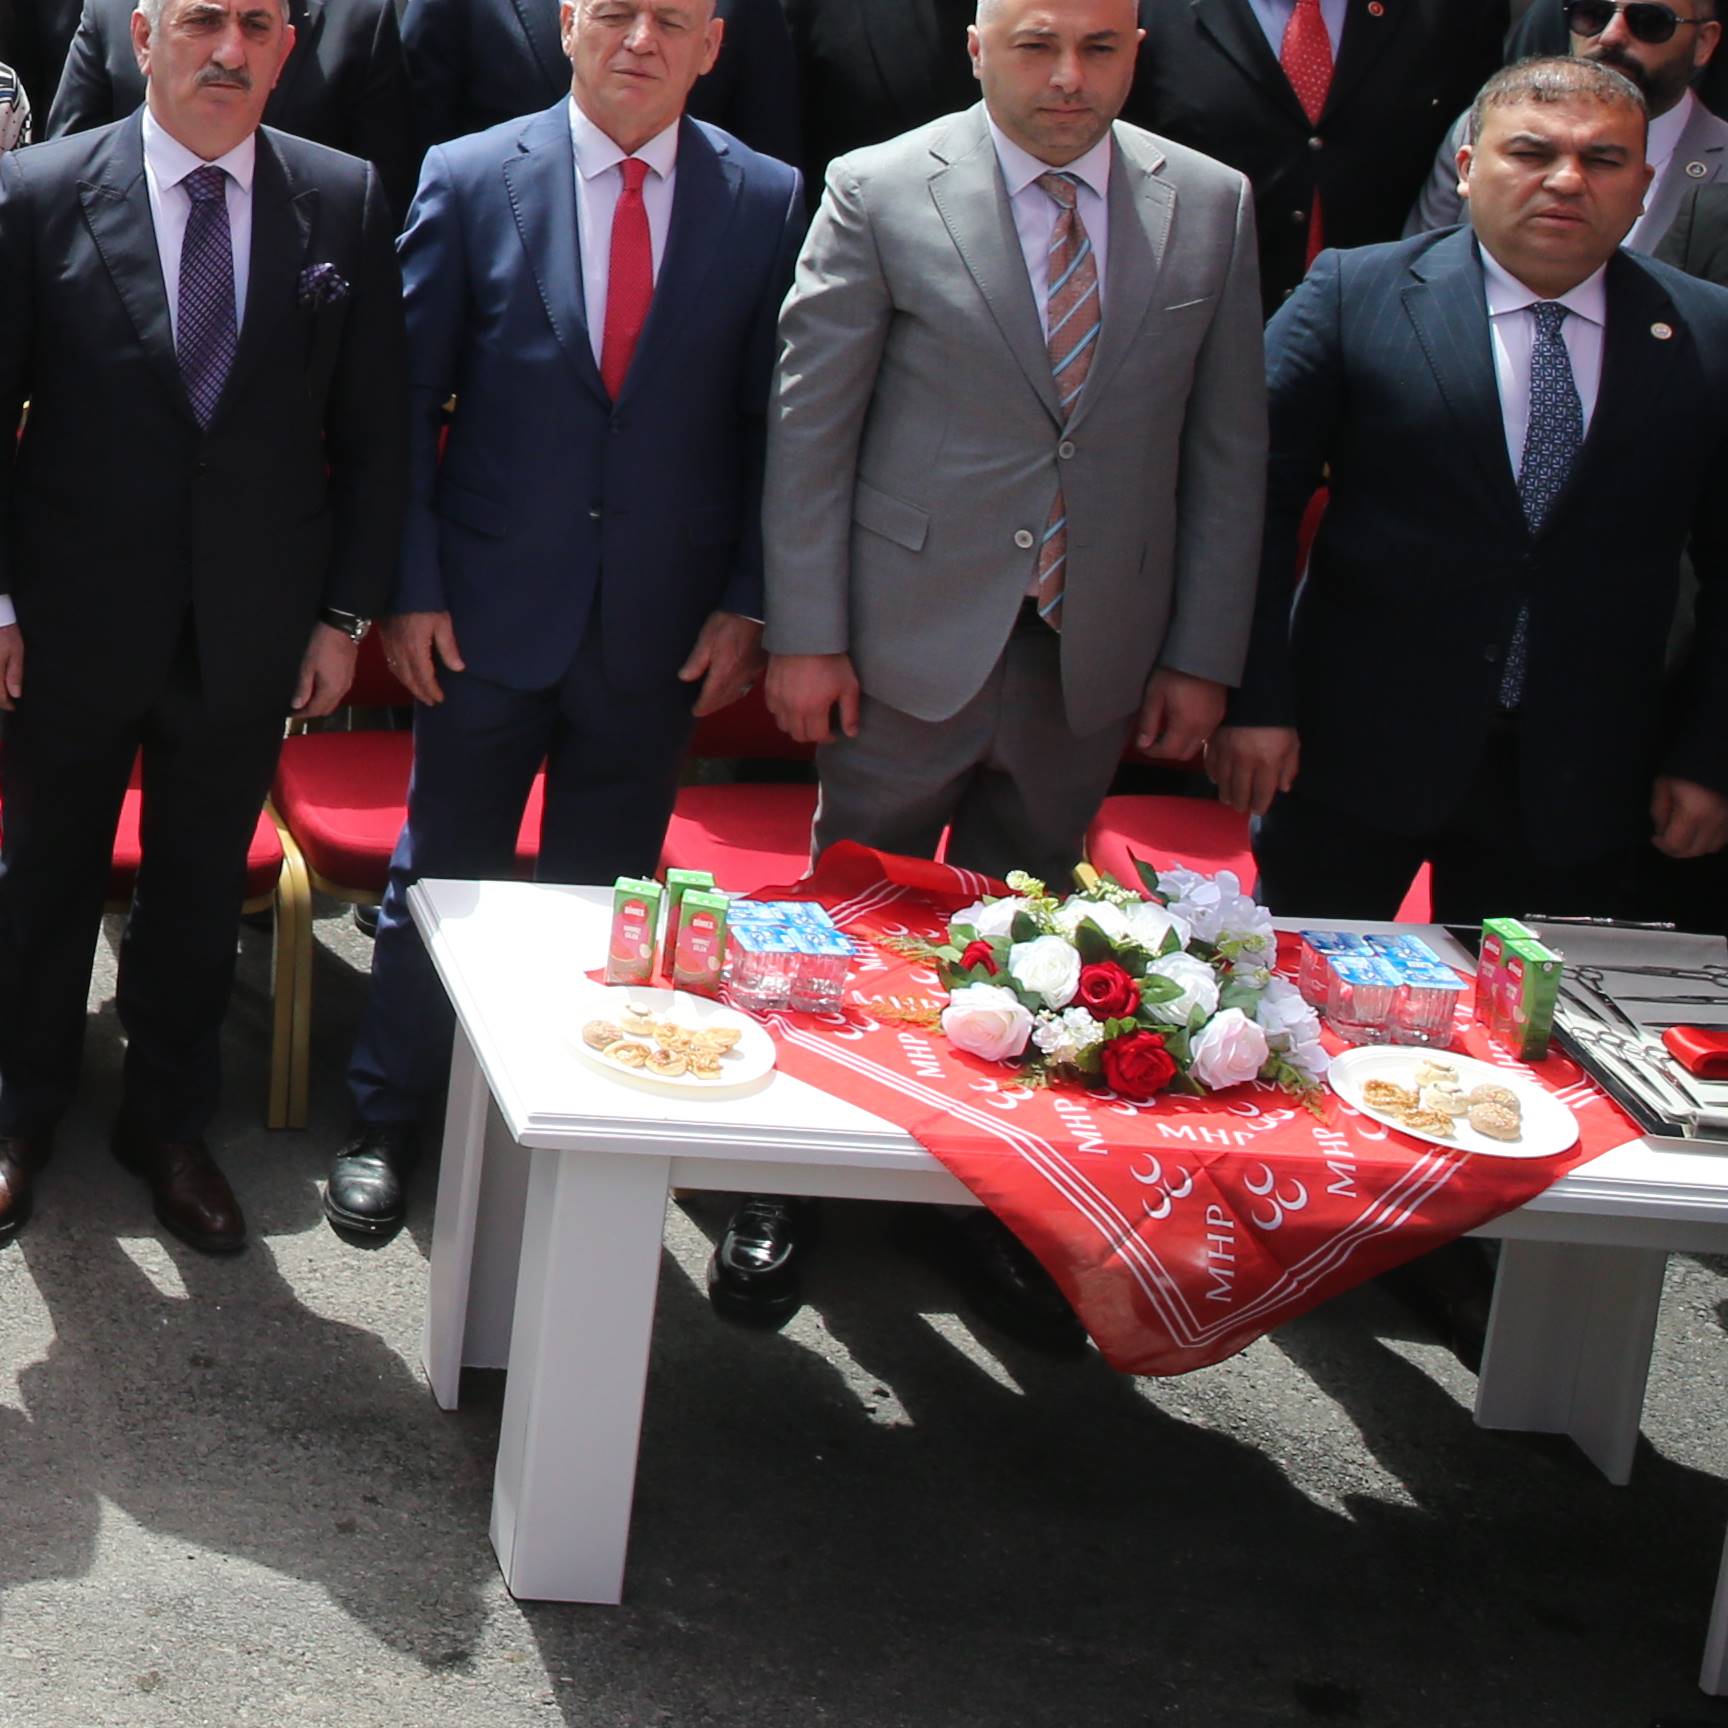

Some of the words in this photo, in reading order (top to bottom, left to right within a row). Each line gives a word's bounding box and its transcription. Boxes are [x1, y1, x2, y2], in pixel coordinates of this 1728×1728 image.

[898, 1032, 946, 1079] MHP
[1054, 1098, 1109, 1156] MHP
[1312, 1127, 1358, 1199] MHP
[1205, 1204, 1235, 1303] MHP
